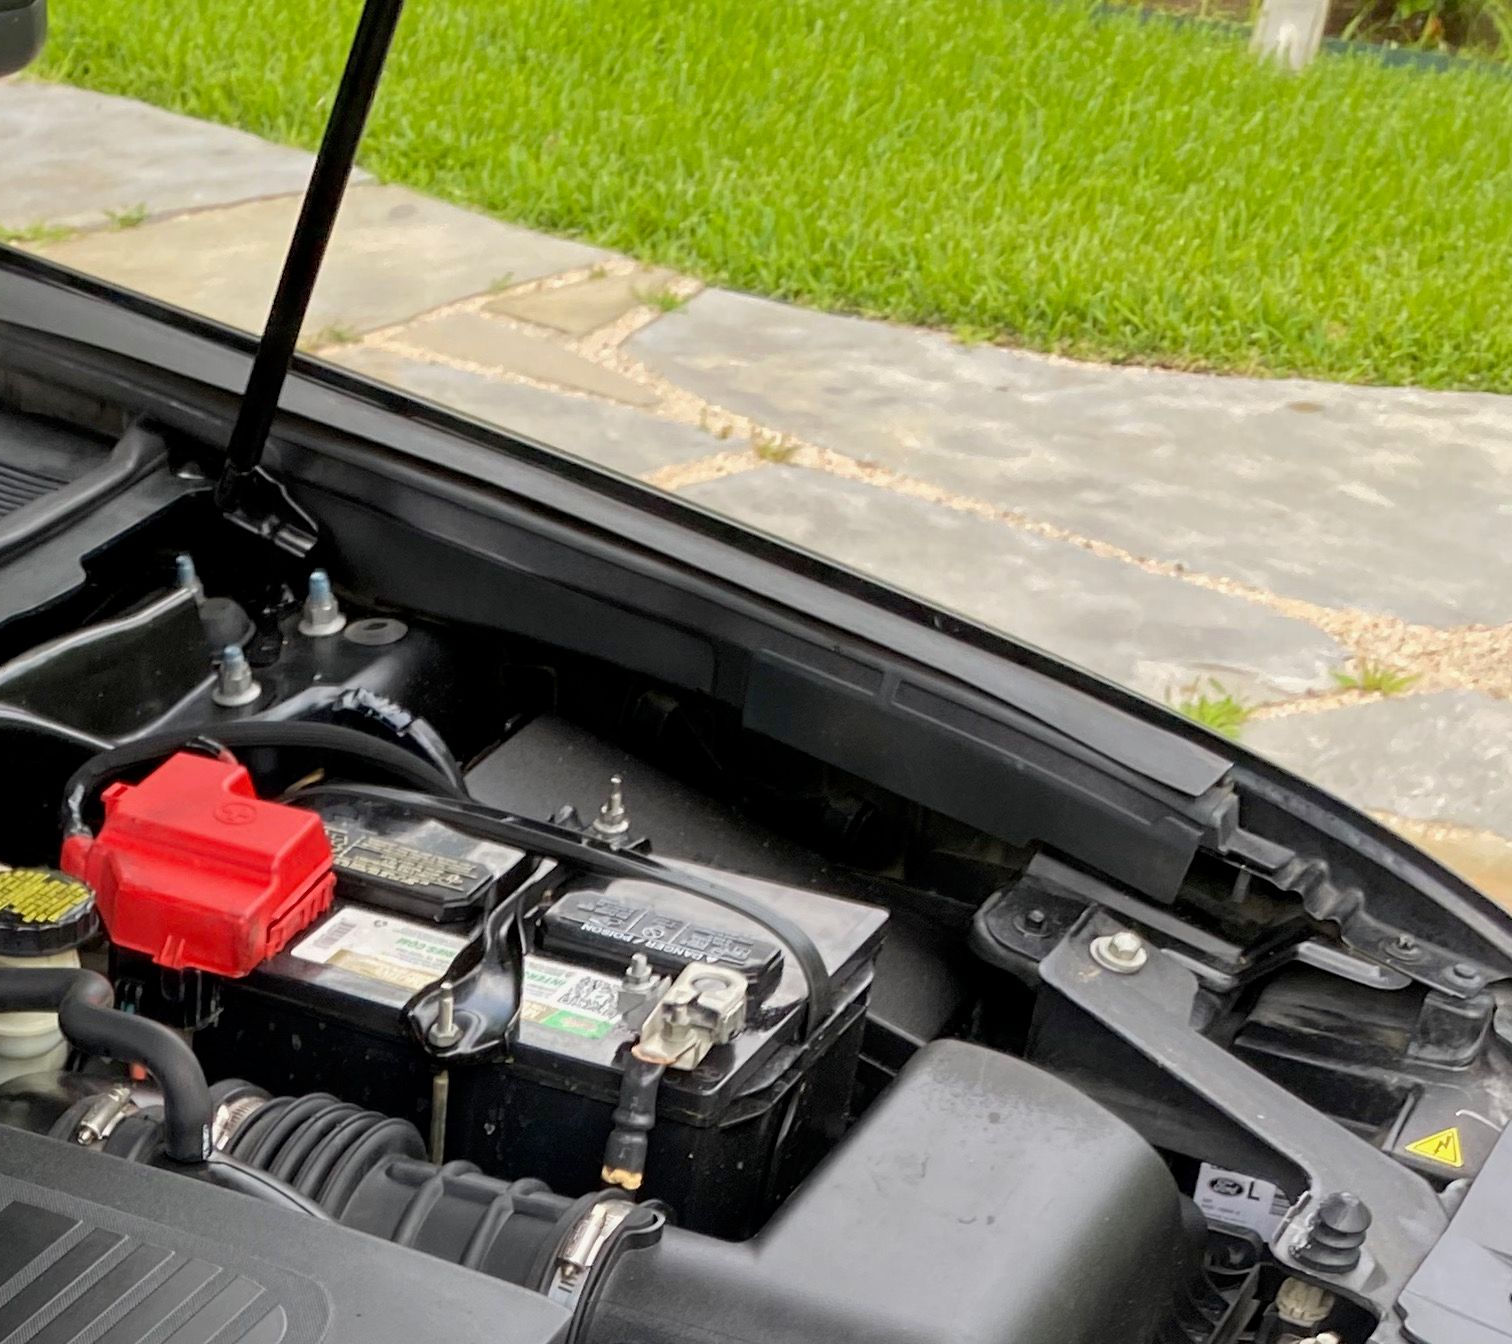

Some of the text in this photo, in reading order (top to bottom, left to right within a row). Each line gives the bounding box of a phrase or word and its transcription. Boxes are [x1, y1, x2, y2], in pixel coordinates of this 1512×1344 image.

[581, 923, 632, 943] POISON
[645, 941, 702, 961] DANGER
[1246, 1181, 1260, 1201] L
